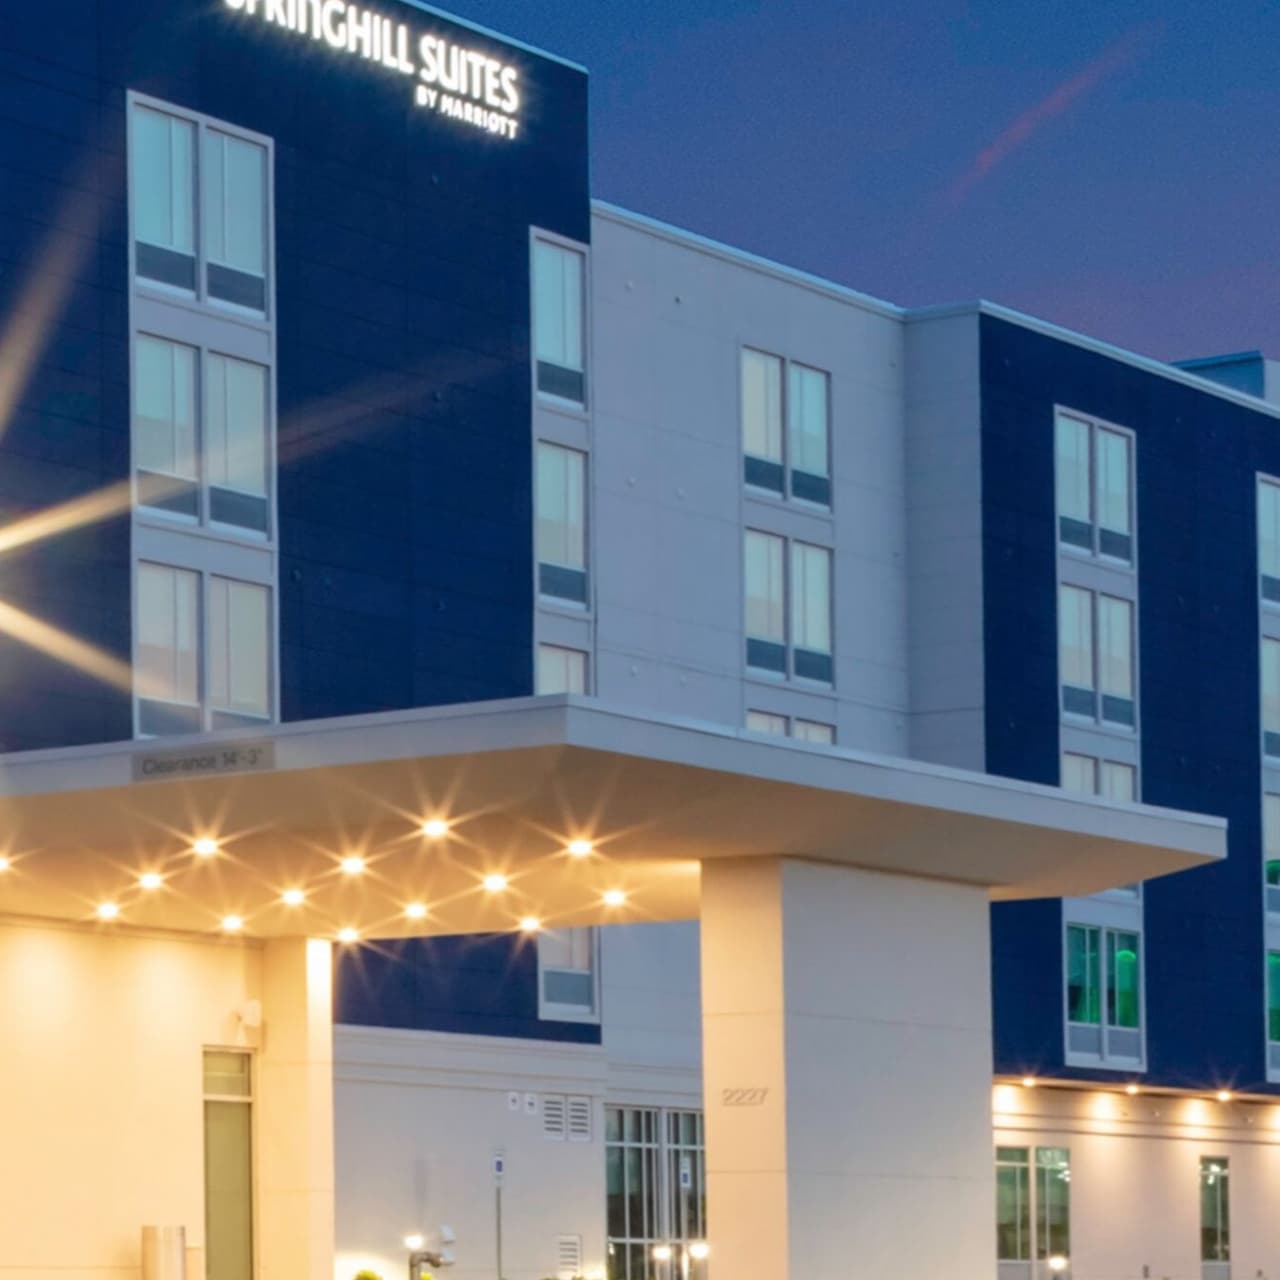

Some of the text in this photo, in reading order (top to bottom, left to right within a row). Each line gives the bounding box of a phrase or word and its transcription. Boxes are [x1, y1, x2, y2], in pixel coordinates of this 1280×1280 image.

[419, 34, 519, 113] SUITES
[416, 84, 518, 139] BY MARRIOTT
[721, 1087, 769, 1107] 2227
